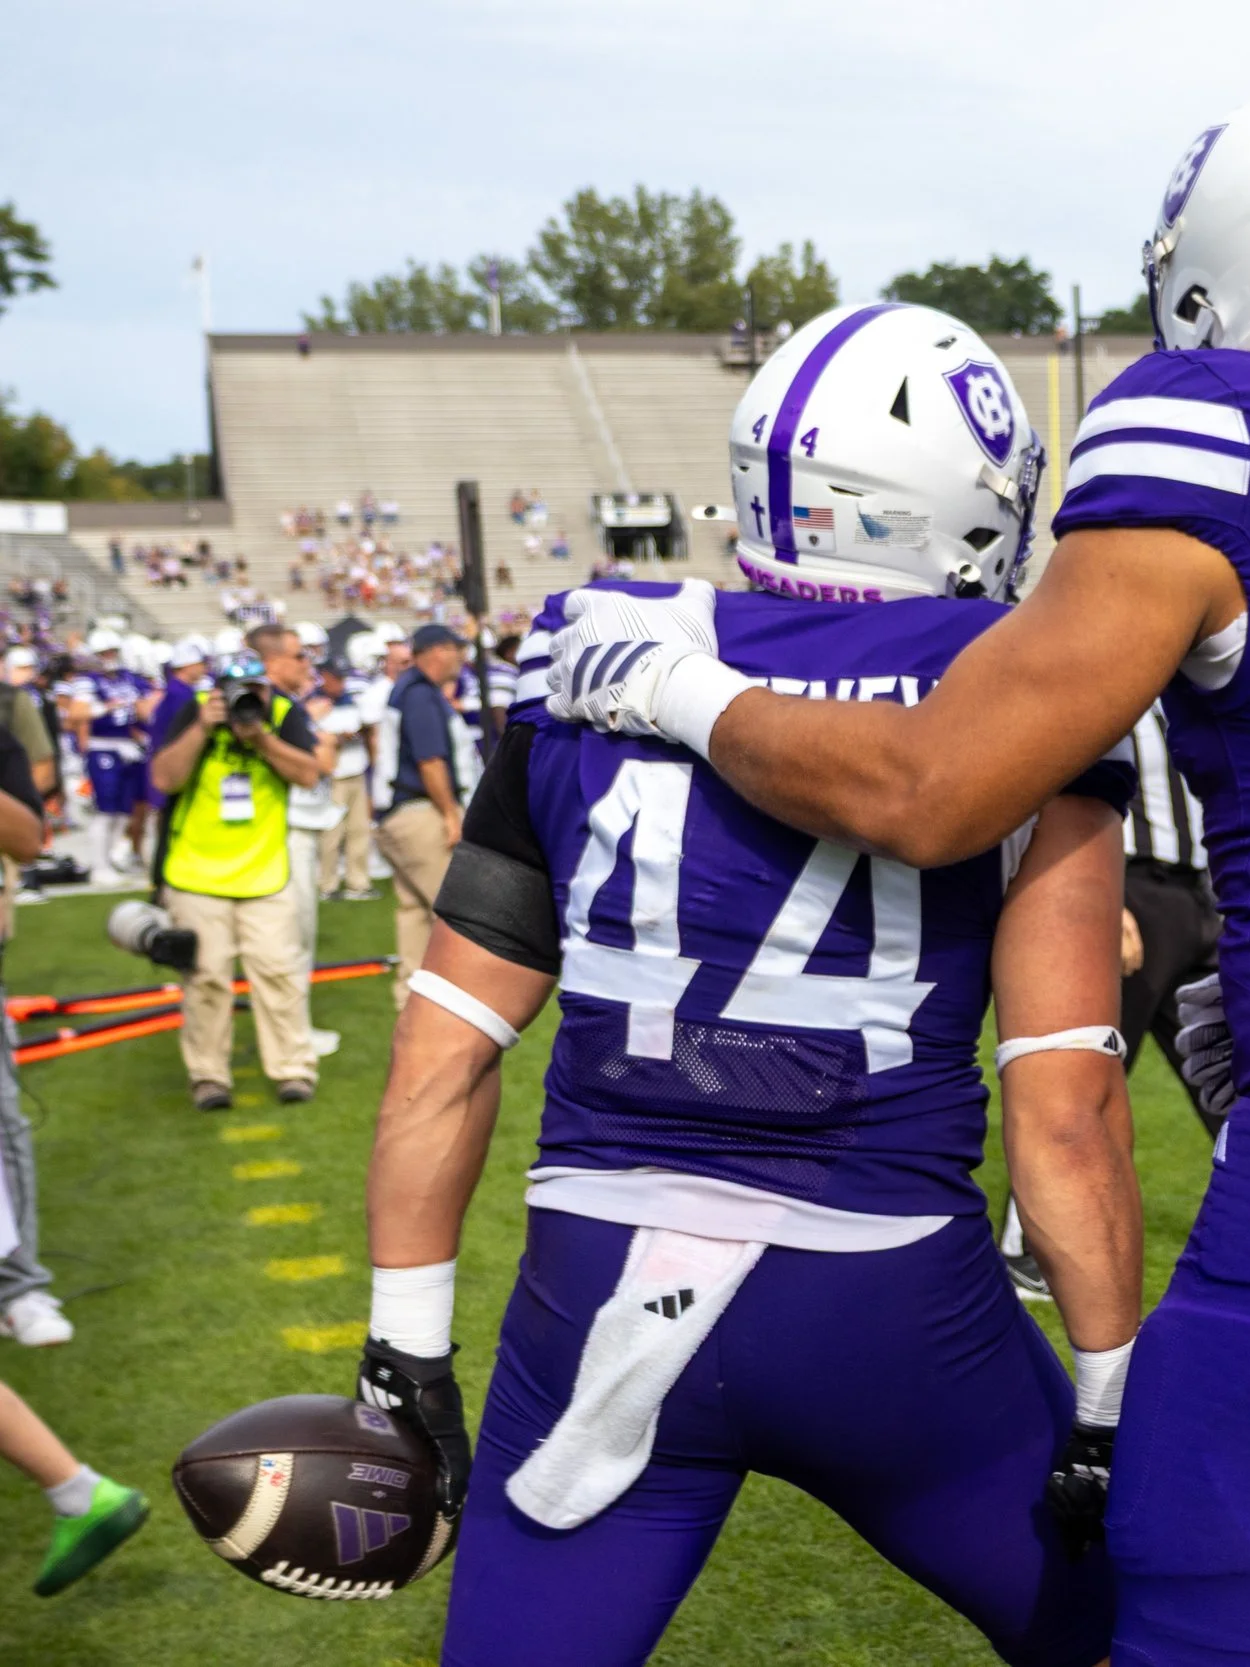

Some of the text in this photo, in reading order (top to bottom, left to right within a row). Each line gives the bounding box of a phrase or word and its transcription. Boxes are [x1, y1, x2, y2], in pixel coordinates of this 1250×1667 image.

[752, 413, 820, 458] 4 4
[558, 758, 938, 1074] 44
[346, 1462, 411, 1490] DIME
